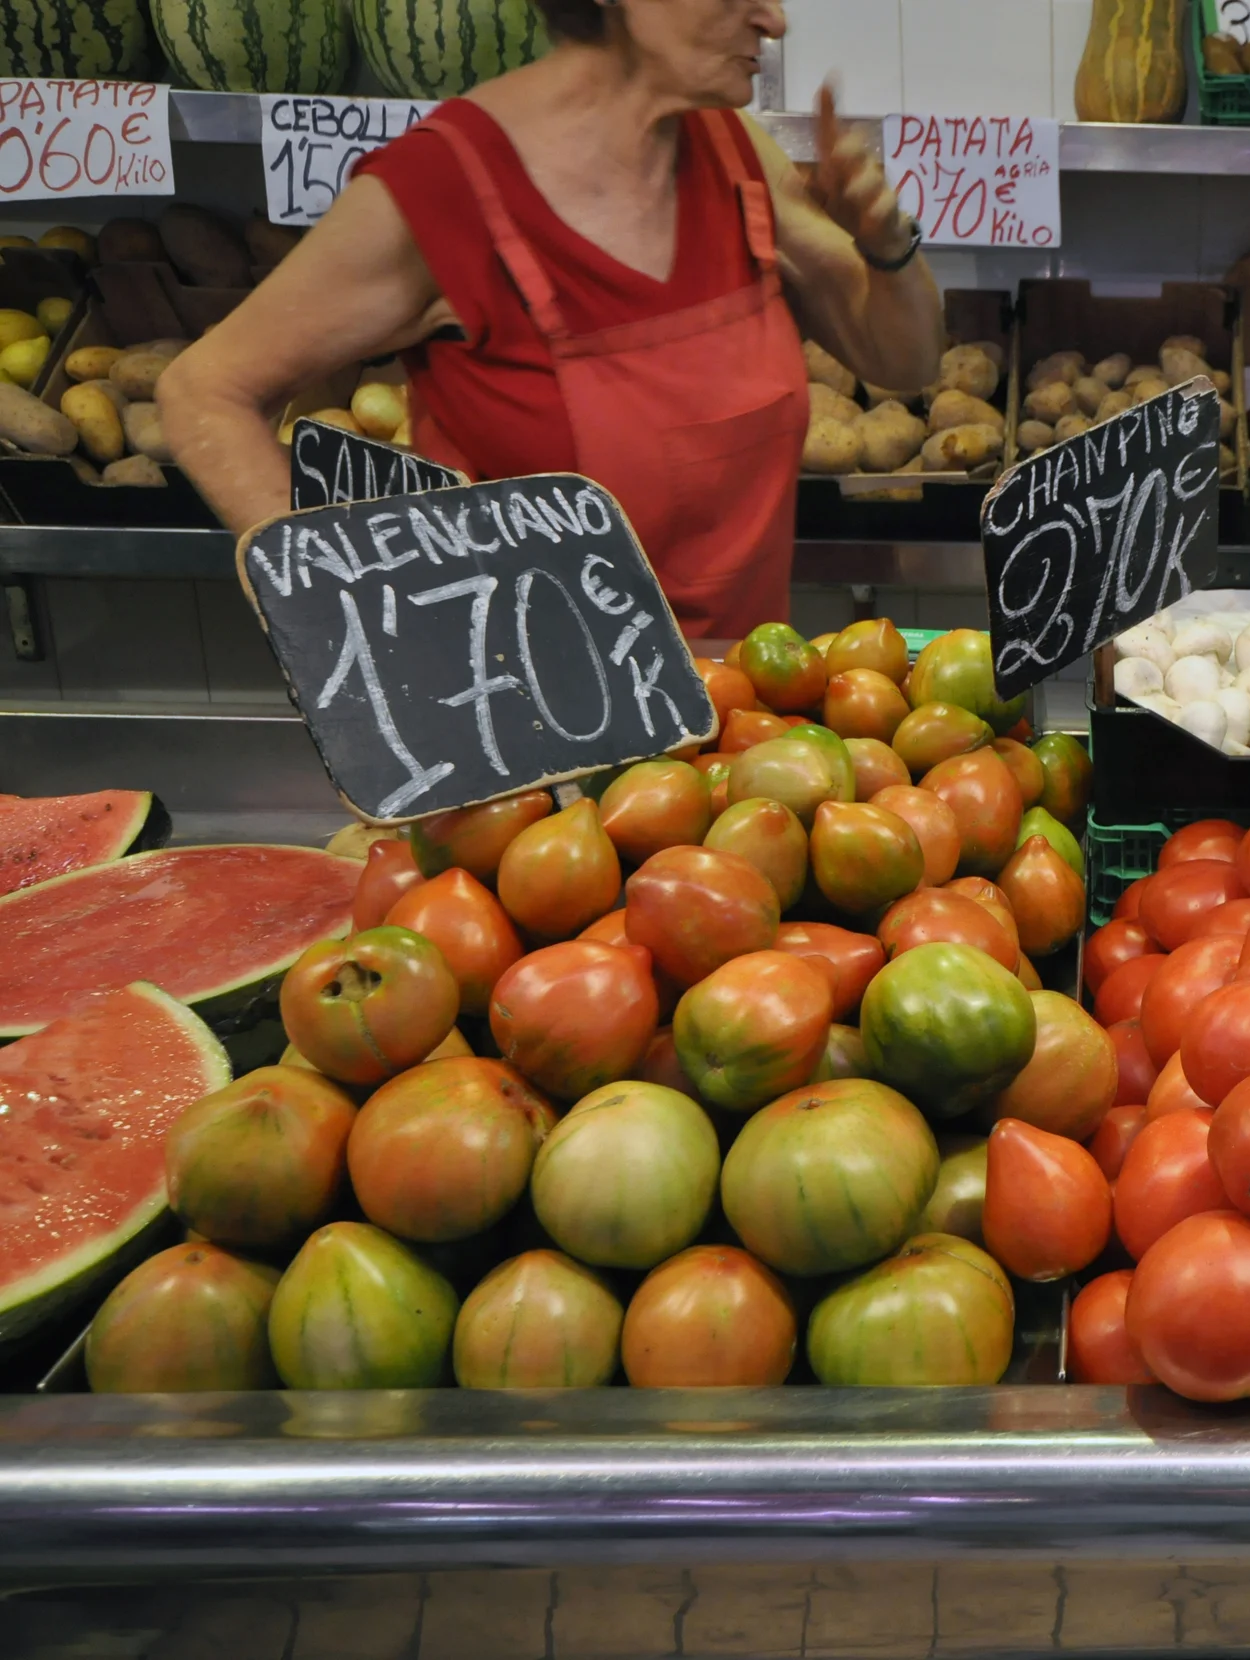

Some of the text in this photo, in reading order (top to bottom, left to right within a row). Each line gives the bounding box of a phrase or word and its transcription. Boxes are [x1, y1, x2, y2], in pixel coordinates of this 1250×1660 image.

[0, 79, 156, 123] PATATA
[0, 112, 151, 193] 0'60 €
[892, 115, 1033, 159] PATATA
[995, 181, 1016, 204] €
[251, 486, 612, 598] VALENCIANO
[317, 566, 612, 820] 1'70
